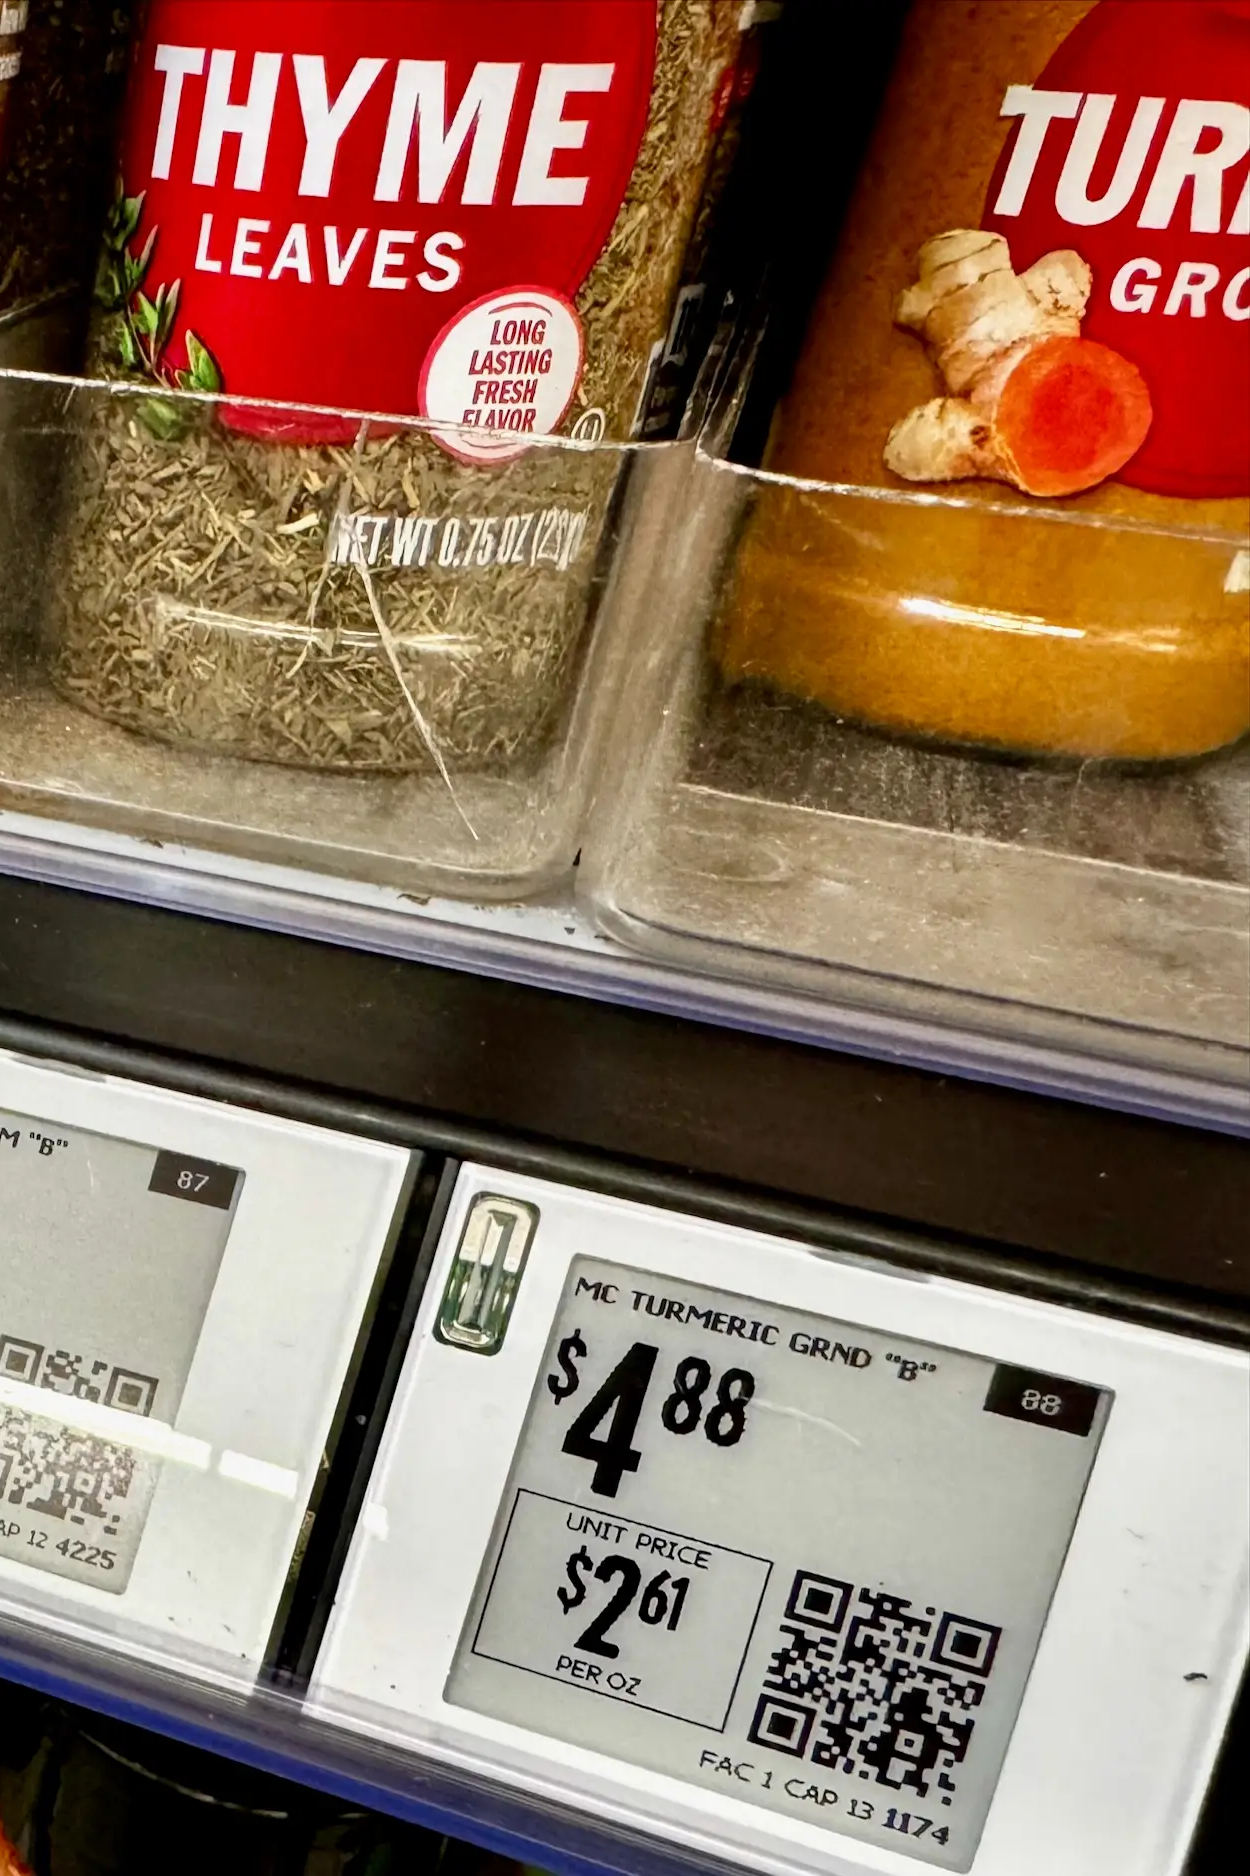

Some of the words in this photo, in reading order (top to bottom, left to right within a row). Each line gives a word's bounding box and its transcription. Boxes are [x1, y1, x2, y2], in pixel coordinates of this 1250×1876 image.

[151, 44, 616, 206] THYME
[993, 84, 1250, 235] TUR
[194, 213, 466, 292] LEAVES
[490, 319, 546, 345] LONG
[468, 348, 553, 376] LASTING
[472, 378, 538, 405] FRESH
[462, 408, 536, 434] FLAVOR
[332, 514, 388, 565] NET
[391, 516, 441, 567] WT
[438, 515, 499, 567] 0.75
[497, 511, 535, 566] OZ
[177, 1170, 209, 1192] 87
[574, 1277, 620, 1306] MC
[631, 1290, 780, 1345] TURMERIC
[788, 1332, 872, 1369] GRND
[1021, 1388, 1062, 1415] 88
[26, 1530, 49, 1549] 12
[55, 1538, 117, 1570] 4225
[566, 1512, 629, 1544] UNIT
[635, 1532, 713, 1570] PRICE
[555, 1655, 603, 1685] PER
[606, 1672, 642, 1697] OZ
[700, 1750, 755, 1782] FAC
[761, 1771, 773, 1790] 1
[784, 1778, 839, 1806] CAP
[846, 1799, 875, 1821] 13
[881, 1808, 950, 1847] 1174
